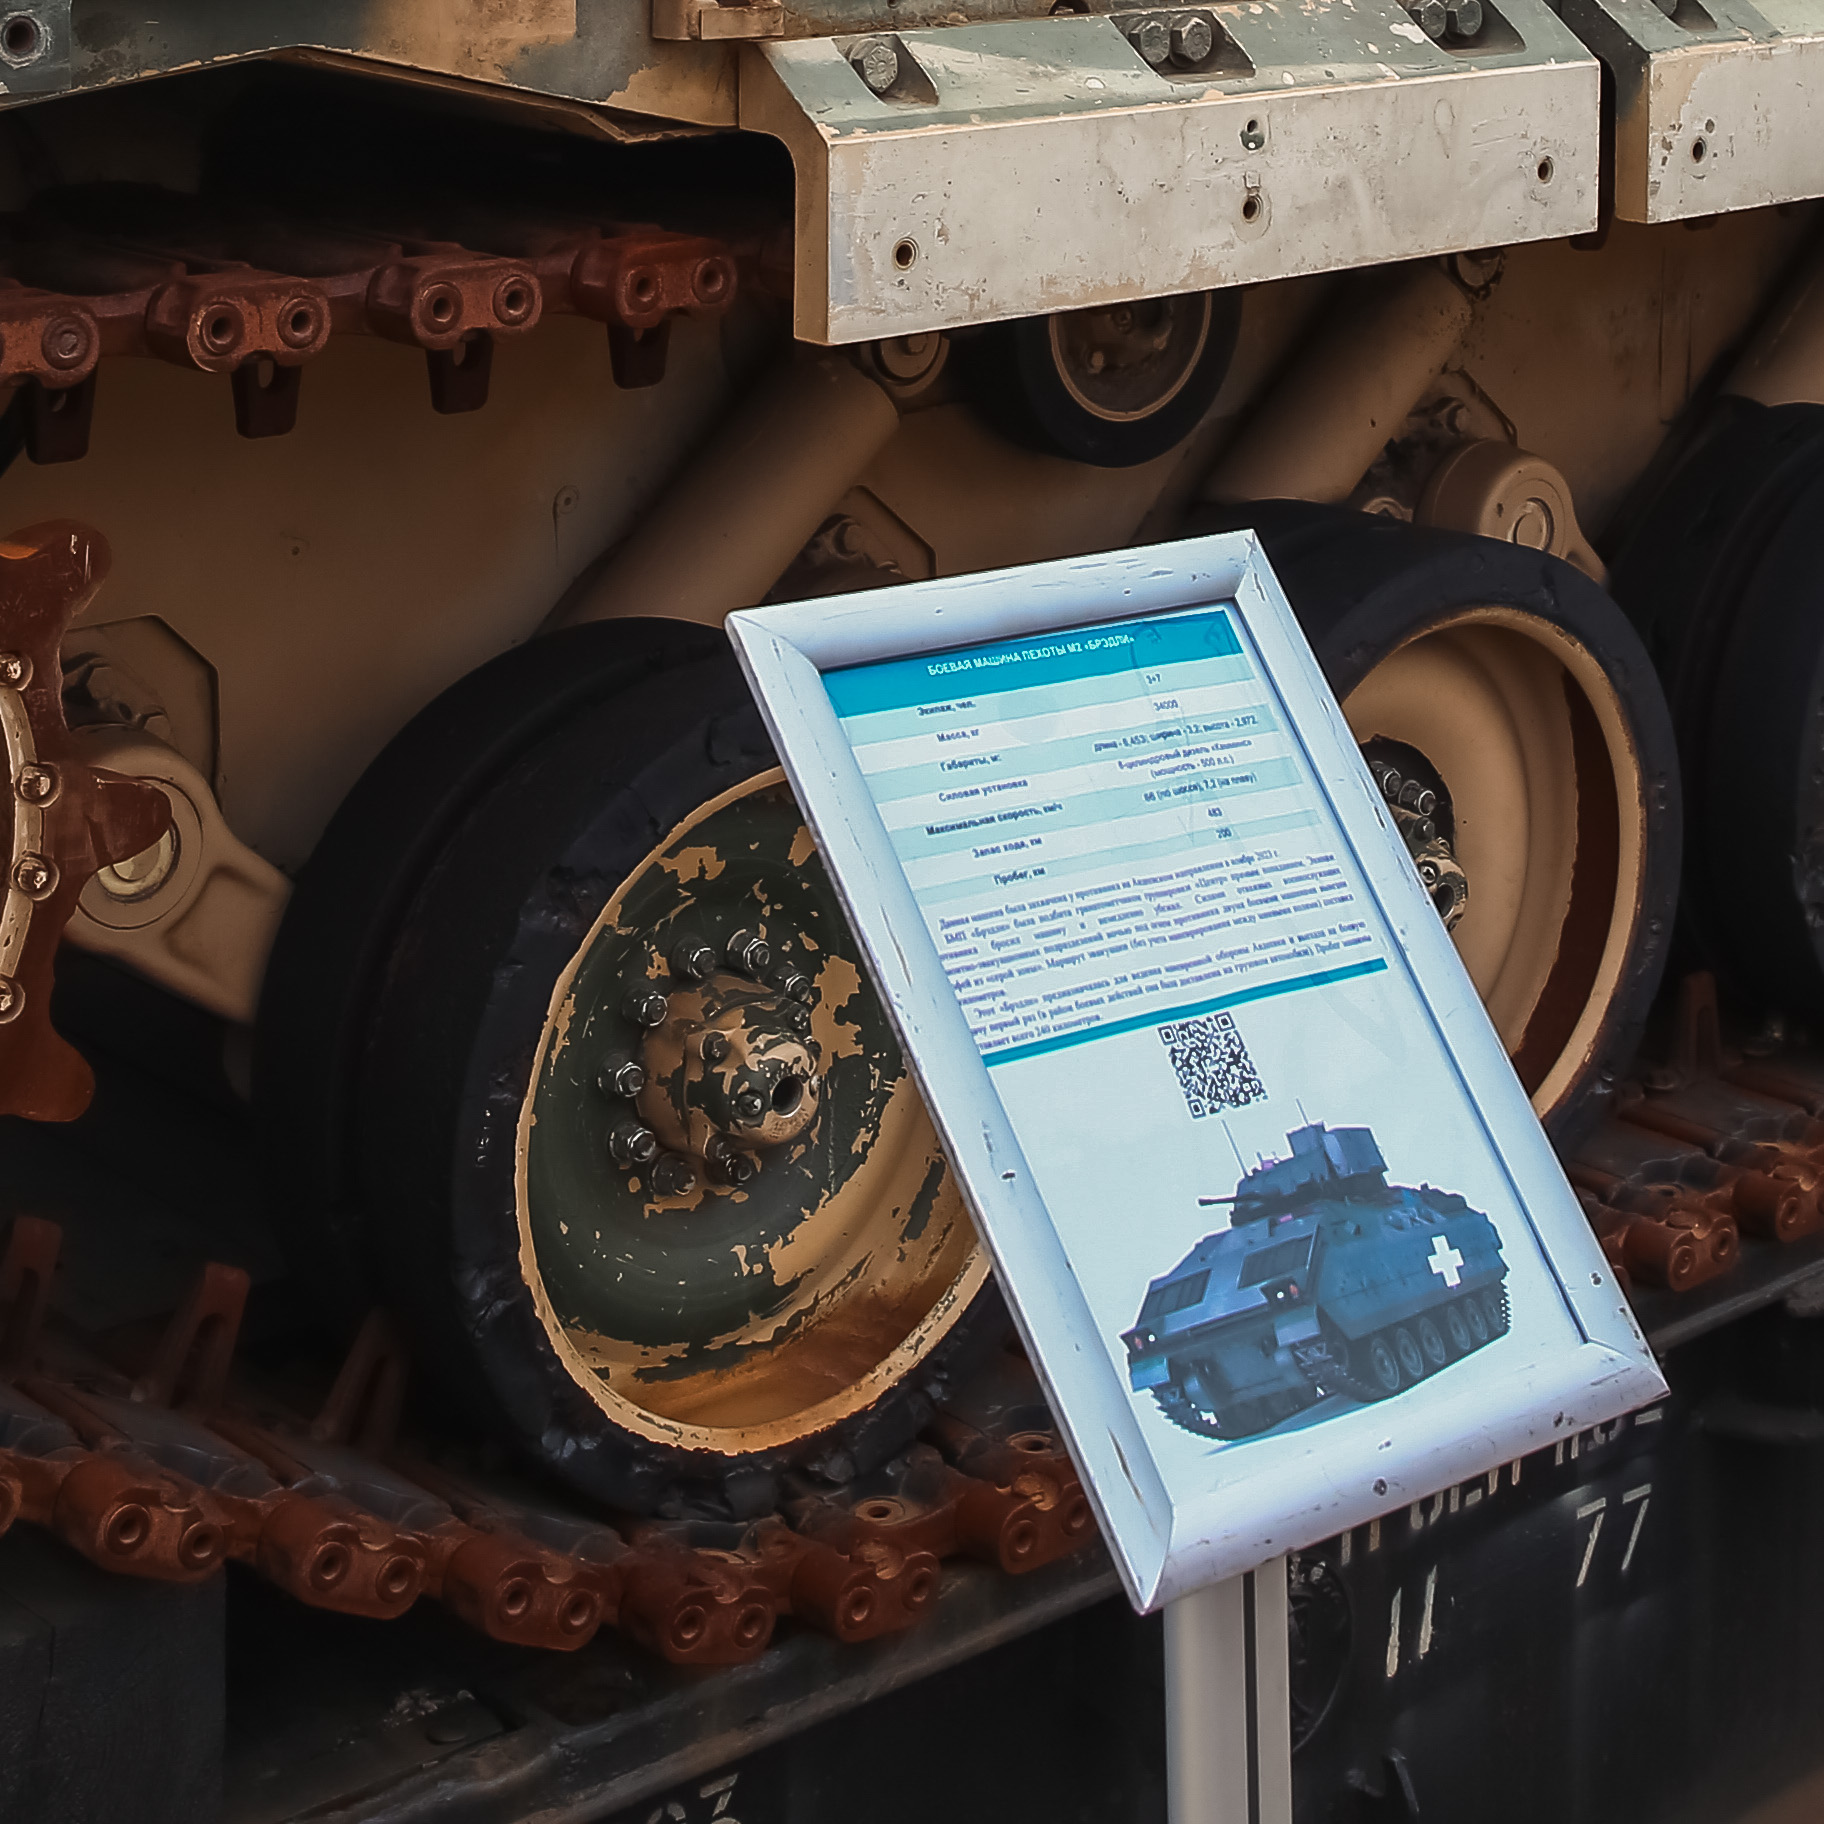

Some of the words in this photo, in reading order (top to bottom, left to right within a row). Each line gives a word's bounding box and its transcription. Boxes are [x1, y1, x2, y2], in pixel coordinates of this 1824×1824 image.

[926, 658, 973, 676] БОЕВАЯ
[972, 651, 1022, 669] МАШИНА
[1020, 643, 1068, 661] ПЕХОТЫ
[1081, 632, 1136, 651] «БРЭДЛИ»
[1577, 1483, 1652, 1589] 77
